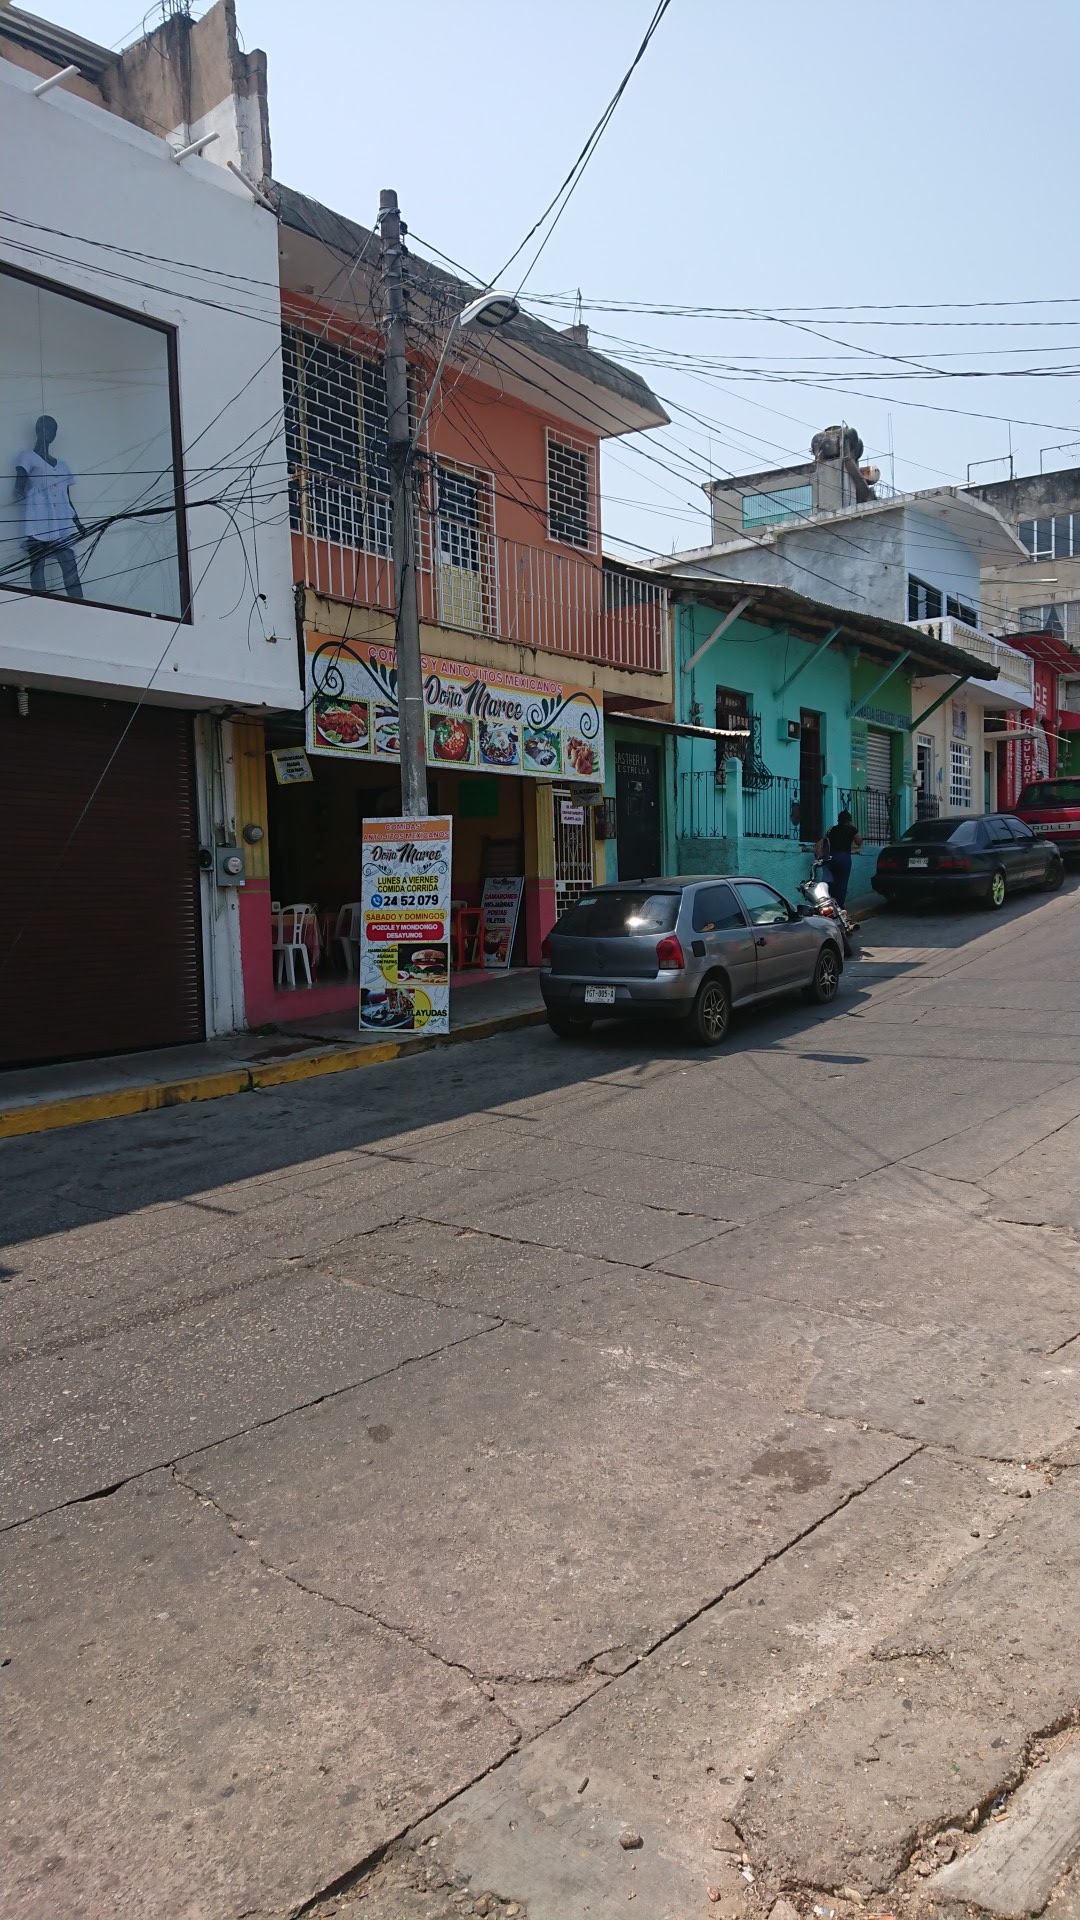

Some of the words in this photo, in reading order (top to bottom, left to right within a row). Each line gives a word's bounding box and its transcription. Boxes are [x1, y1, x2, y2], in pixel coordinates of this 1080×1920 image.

[368, 646, 427, 669] COMS
[431, 658, 438, 670] Y
[441, 662, 503, 683] ANTOJITOS
[505, 674, 563, 694] MEXICANOS
[424, 674, 463, 709] Doña
[461, 679, 523, 721] Marce
[1035, 681, 1047, 705] DE
[617, 764, 650, 775] ESTRELLA
[385, 823, 420, 831] COMIDAS
[1032, 823, 1072, 831] ROLET
[363, 833, 404, 841] ANTOJITOS
[405, 831, 449, 839] MEXICANOS
[371, 845, 397, 861] Doña
[397, 843, 442, 864] Marce
[377, 876, 401, 885] LUNES
[402, 876, 408, 884] A
[409, 875, 439, 884] VIERNES
[377, 884, 405, 893] COMIDA
[406, 884, 439, 892] CORRIDA
[383, 896, 398, 906] 24
[400, 895, 415, 906] 52
[417, 894, 439, 905] 079
[405, 912, 445, 920] DOMINGOS
[401, 923, 438, 931] MONDONGO
[386, 931, 423, 939] DESAYUNOS
[406, 1009, 448, 1017] TLAYUDAS
